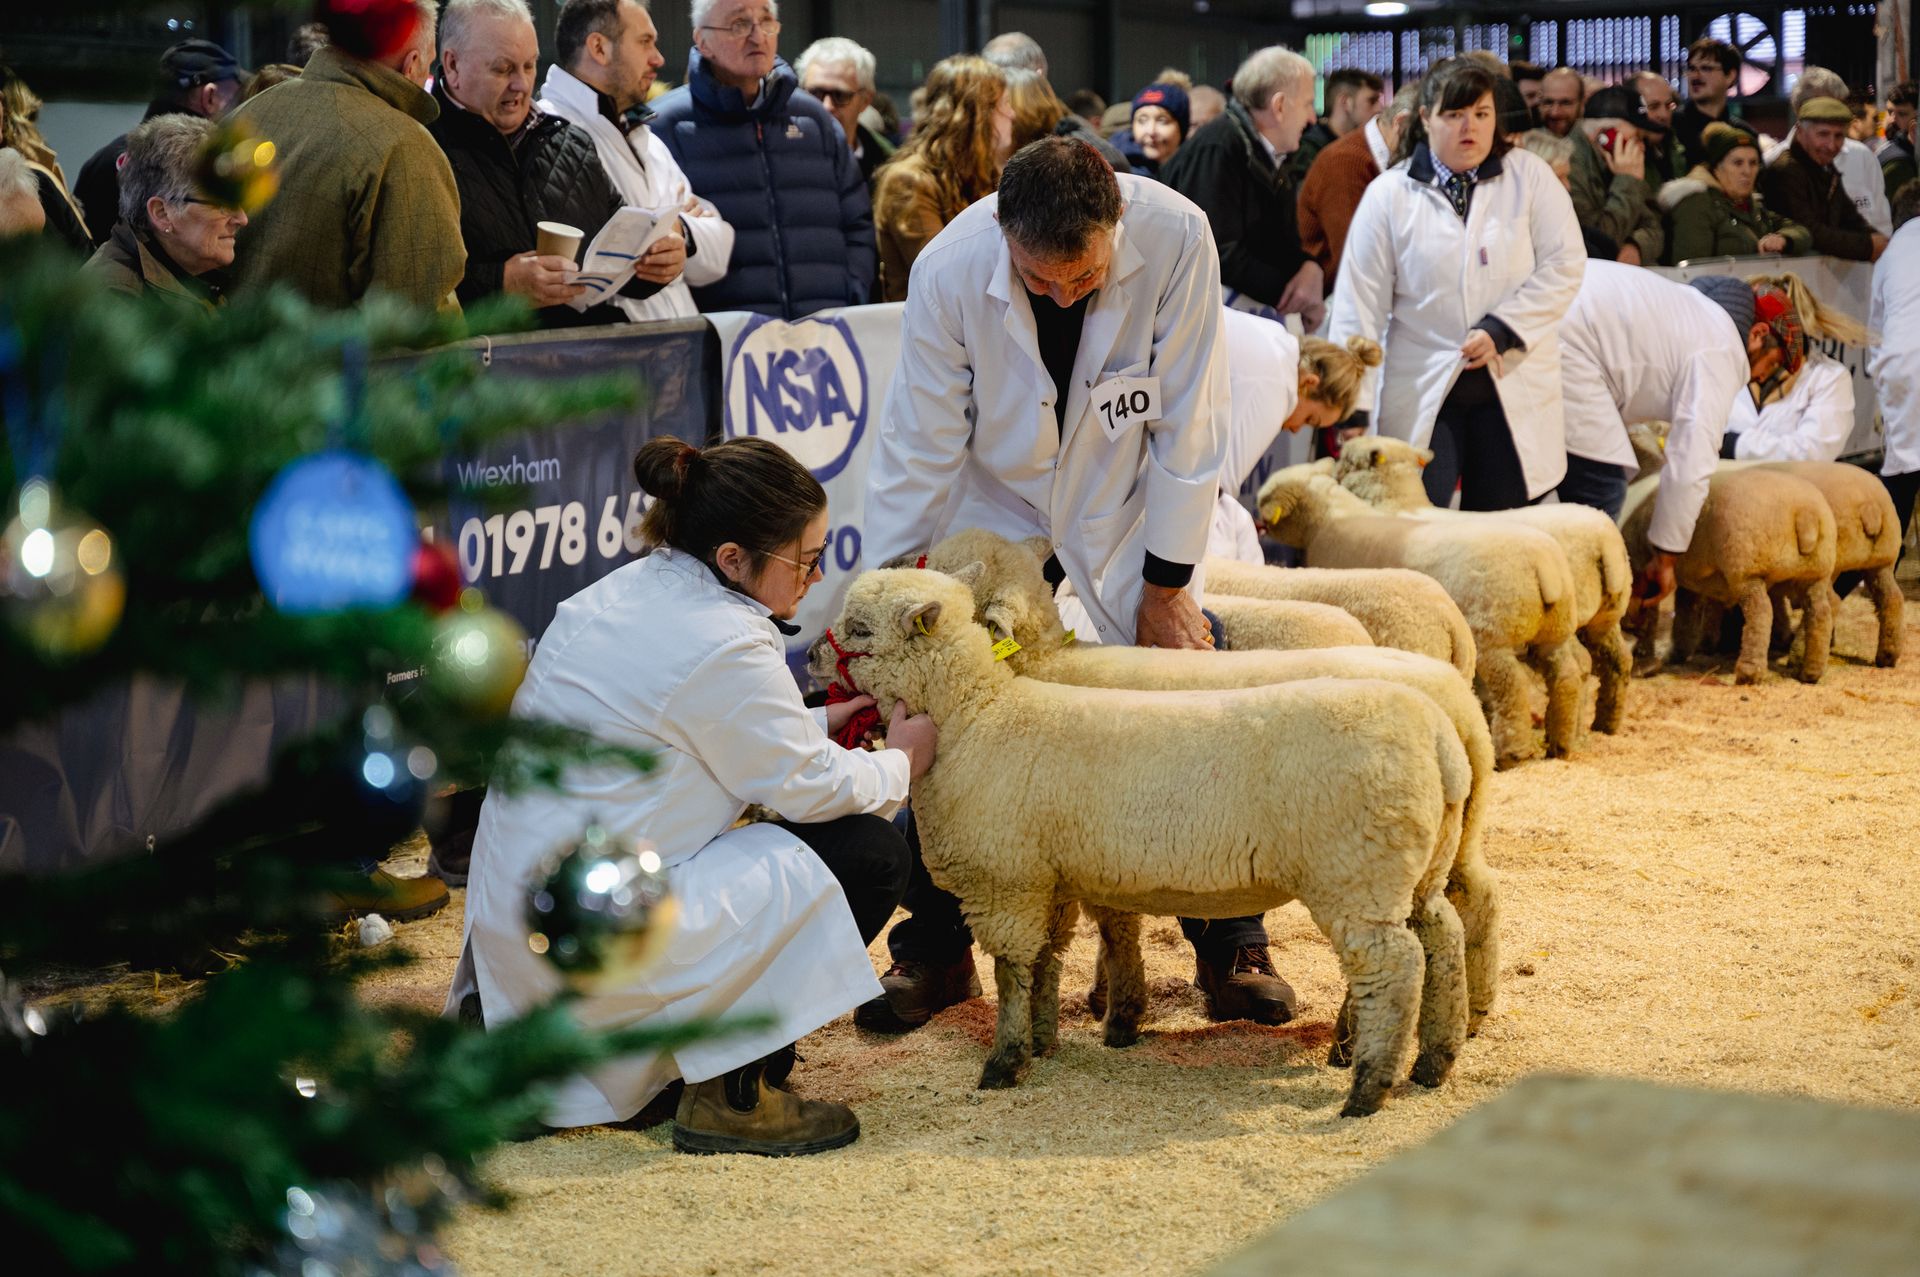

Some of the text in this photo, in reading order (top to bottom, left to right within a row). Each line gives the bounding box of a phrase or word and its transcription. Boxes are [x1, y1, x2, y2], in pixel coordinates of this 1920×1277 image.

[743, 347, 857, 435] NSA
[1100, 390, 1150, 430] 740
[457, 455, 560, 490] Wrexham
[458, 501, 587, 583] 01978
[386, 668, 419, 685] Farmers
